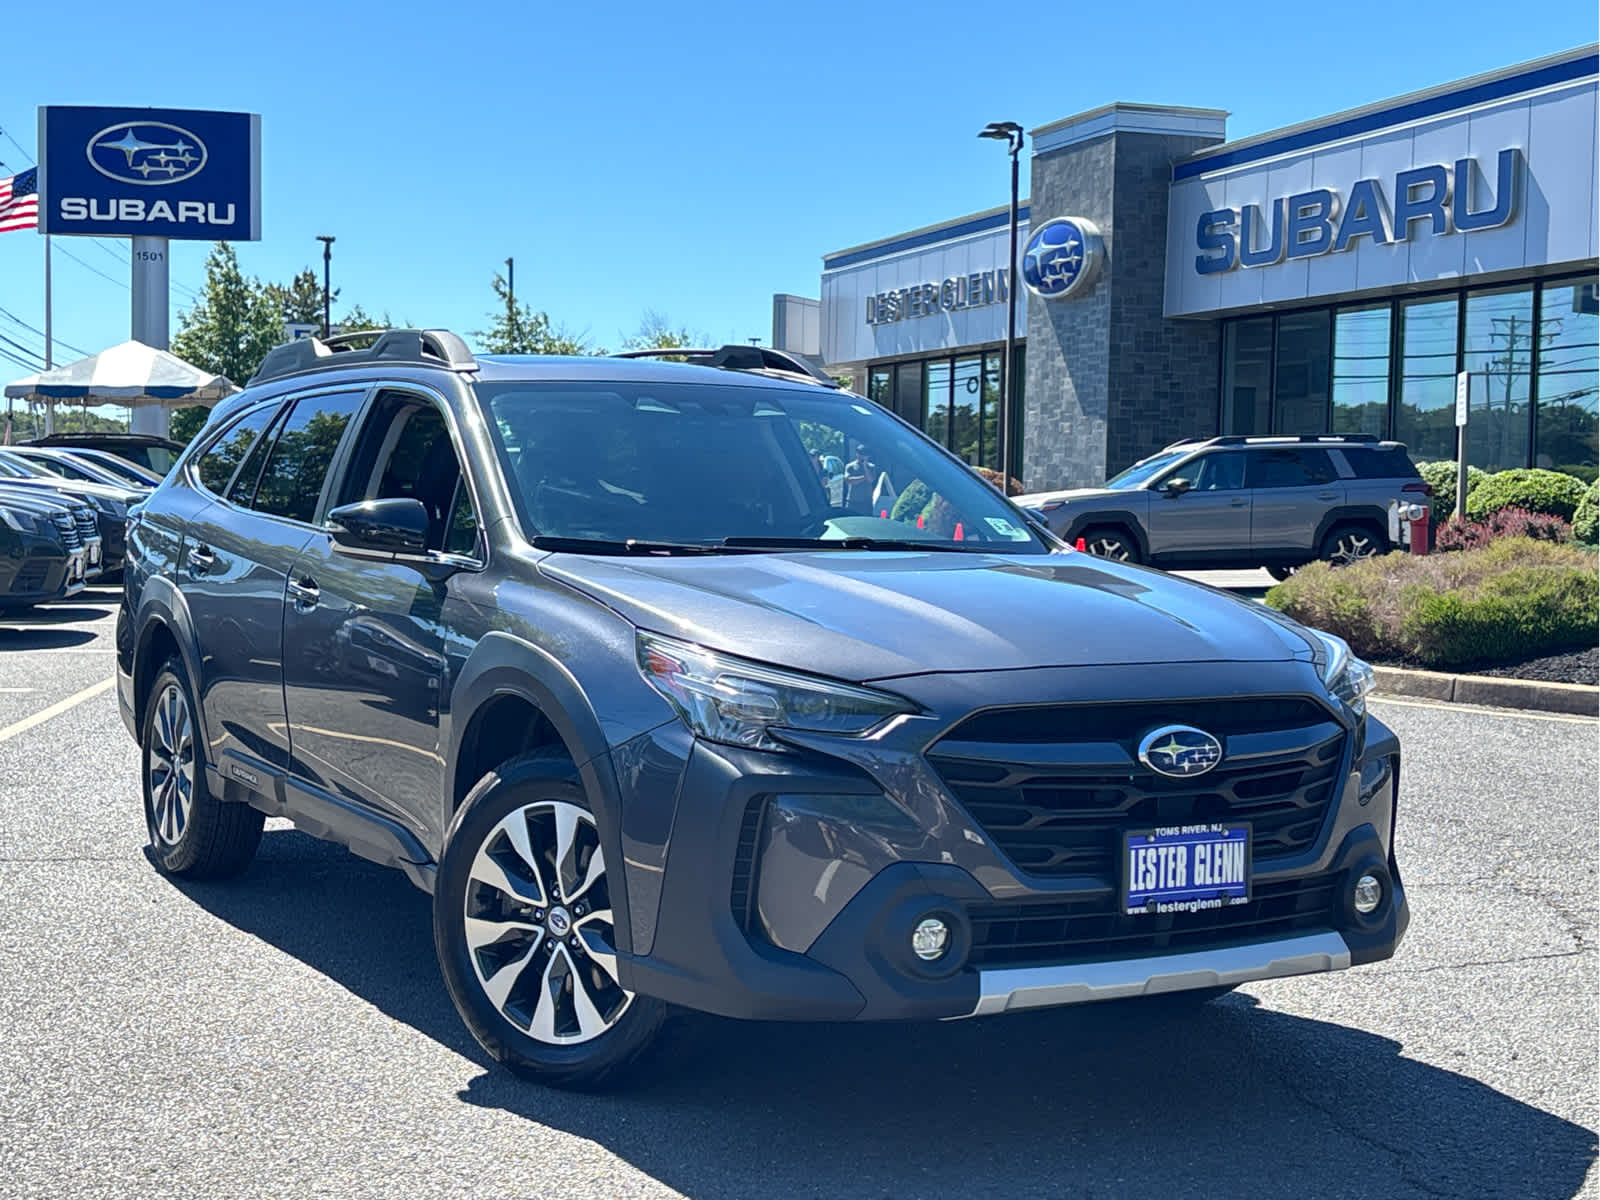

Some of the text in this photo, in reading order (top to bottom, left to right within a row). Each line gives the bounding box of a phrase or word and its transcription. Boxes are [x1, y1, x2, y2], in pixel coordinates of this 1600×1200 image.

[60, 197, 236, 225] SUBARU
[1195, 148, 1521, 275] SUBARU
[136, 251, 164, 262] 1501
[866, 282, 940, 326] LESTER
[1155, 826, 1180, 837] TOMS
[1211, 823, 1223, 833] NJ
[1129, 841, 1245, 891] LESTER GLENN
